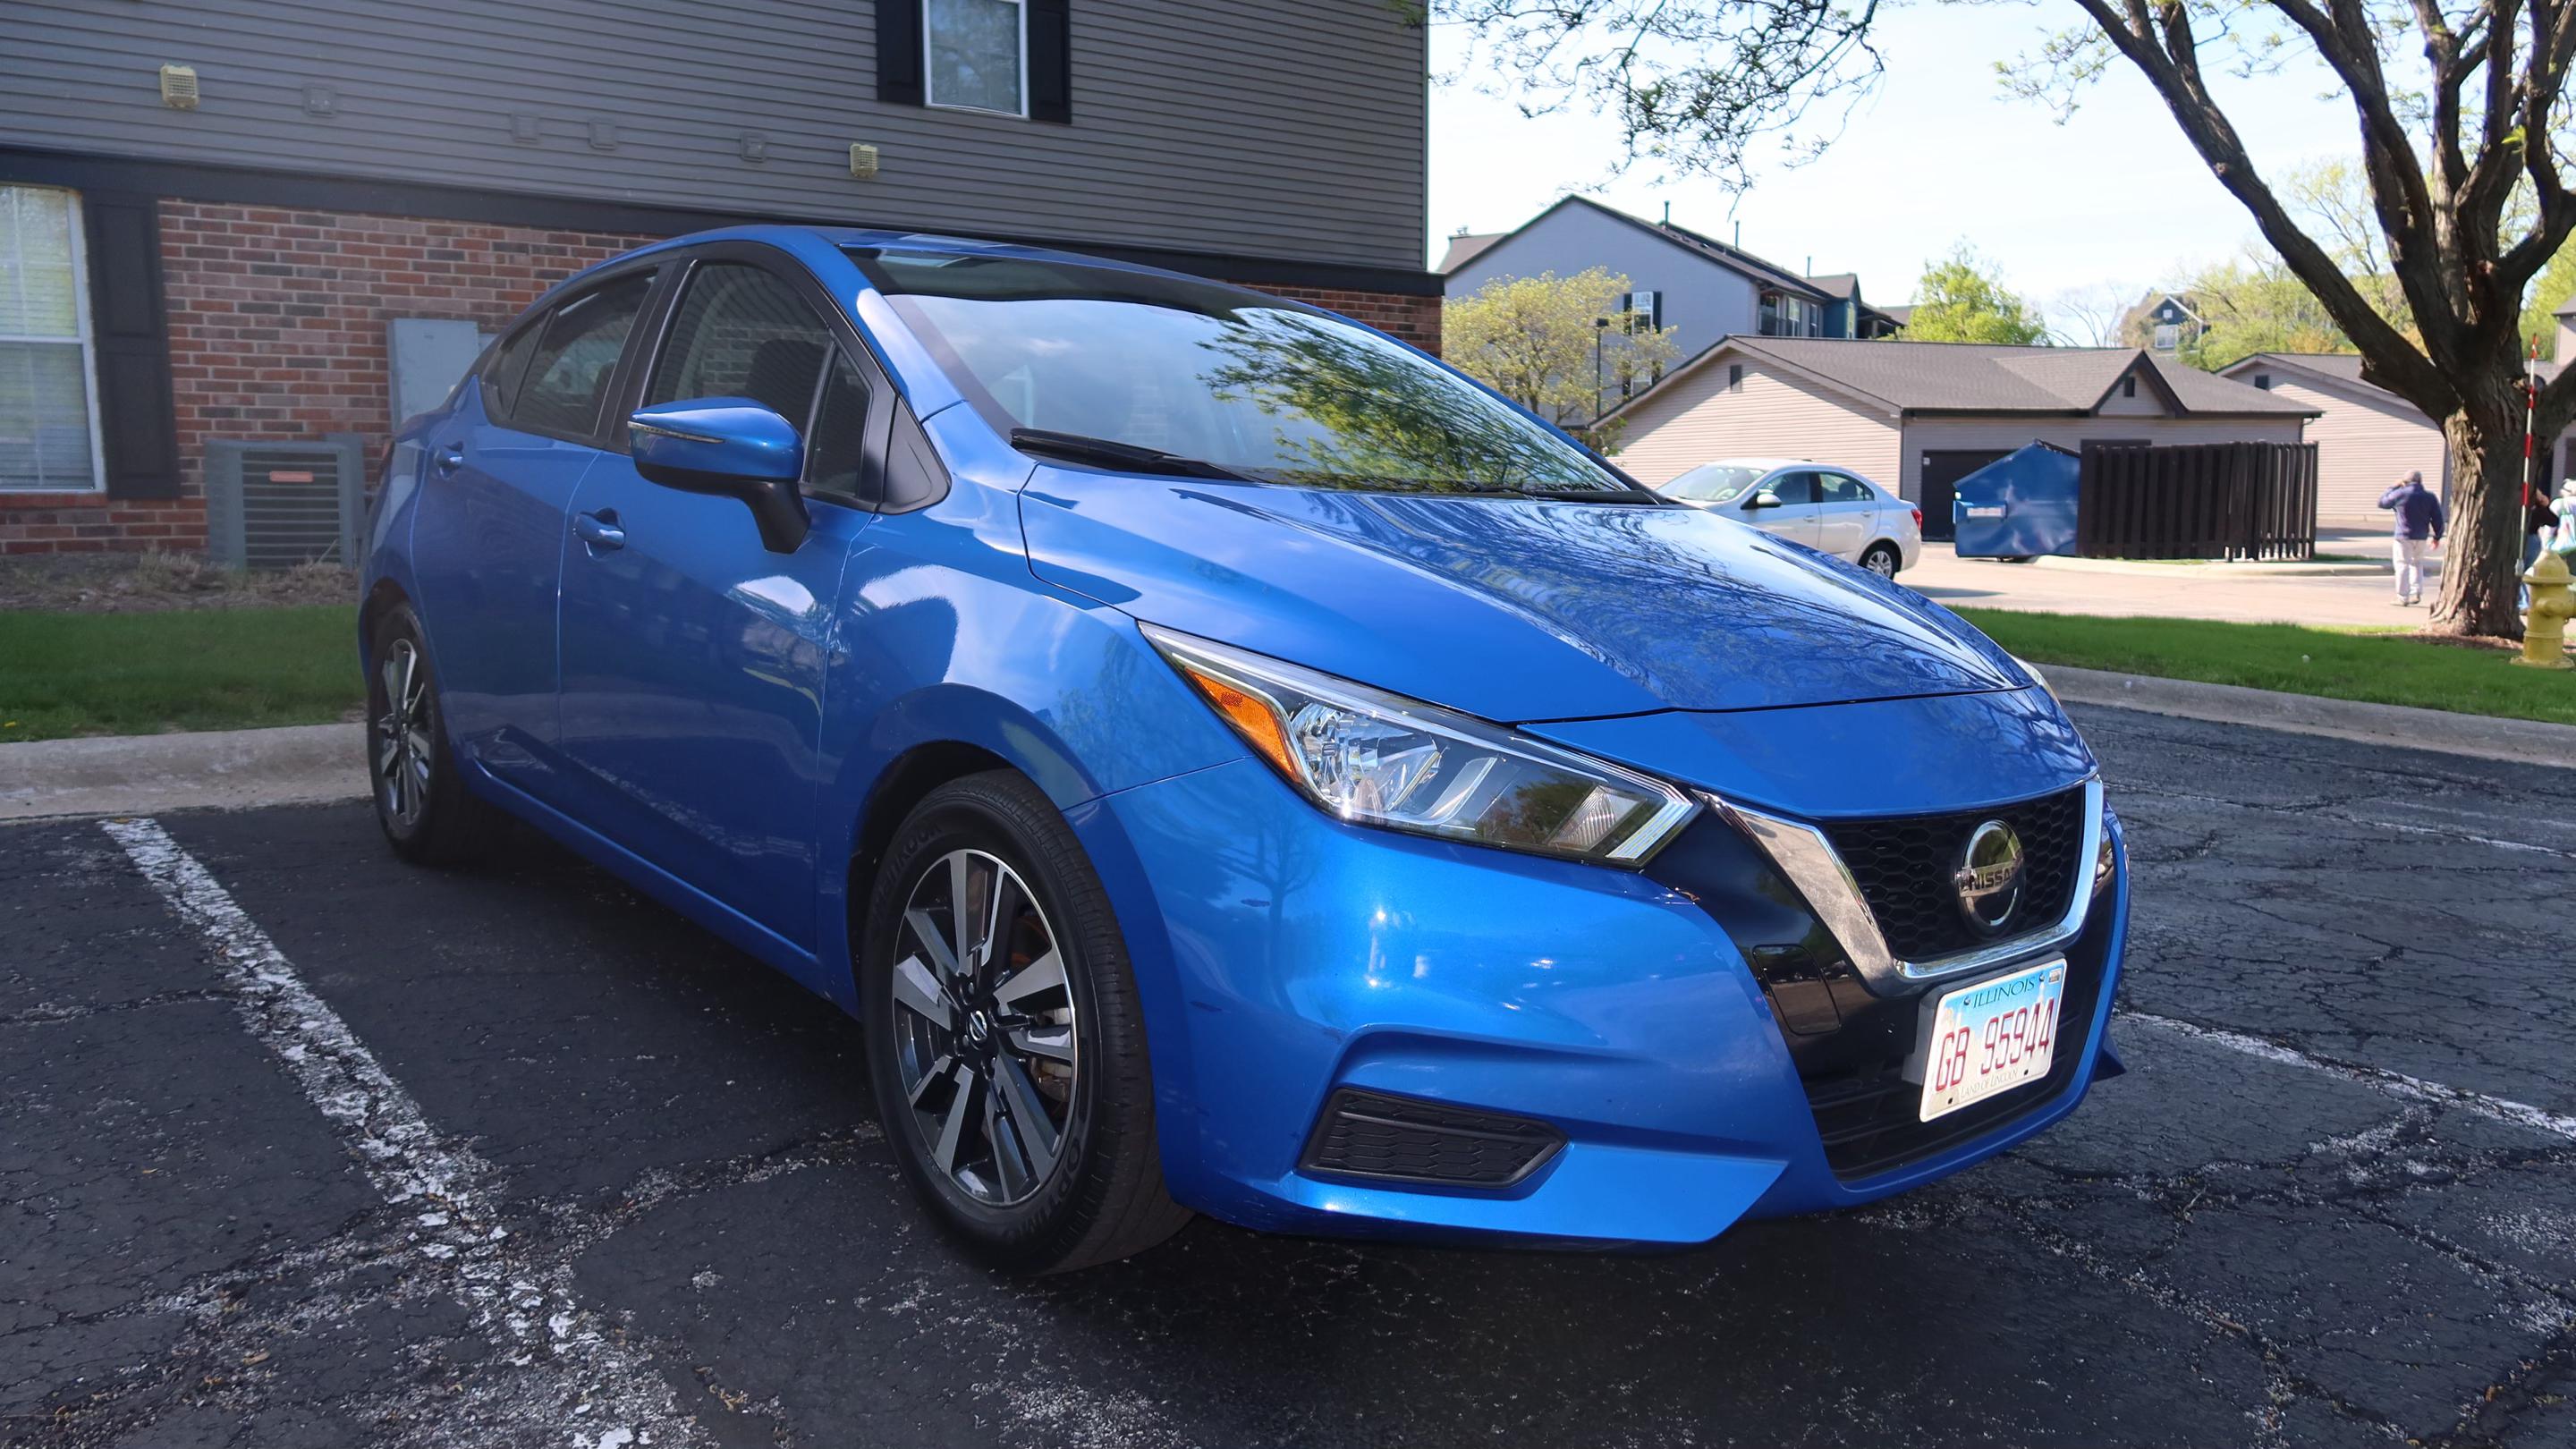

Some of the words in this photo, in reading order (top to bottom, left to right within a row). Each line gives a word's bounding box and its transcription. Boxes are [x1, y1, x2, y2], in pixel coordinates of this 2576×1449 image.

[1968, 867, 2015, 891] NISSA
[1973, 979, 2036, 1009] ILLINOIS
[1935, 1026, 1970, 1092] GB
[1980, 996, 2055, 1075] 95944
